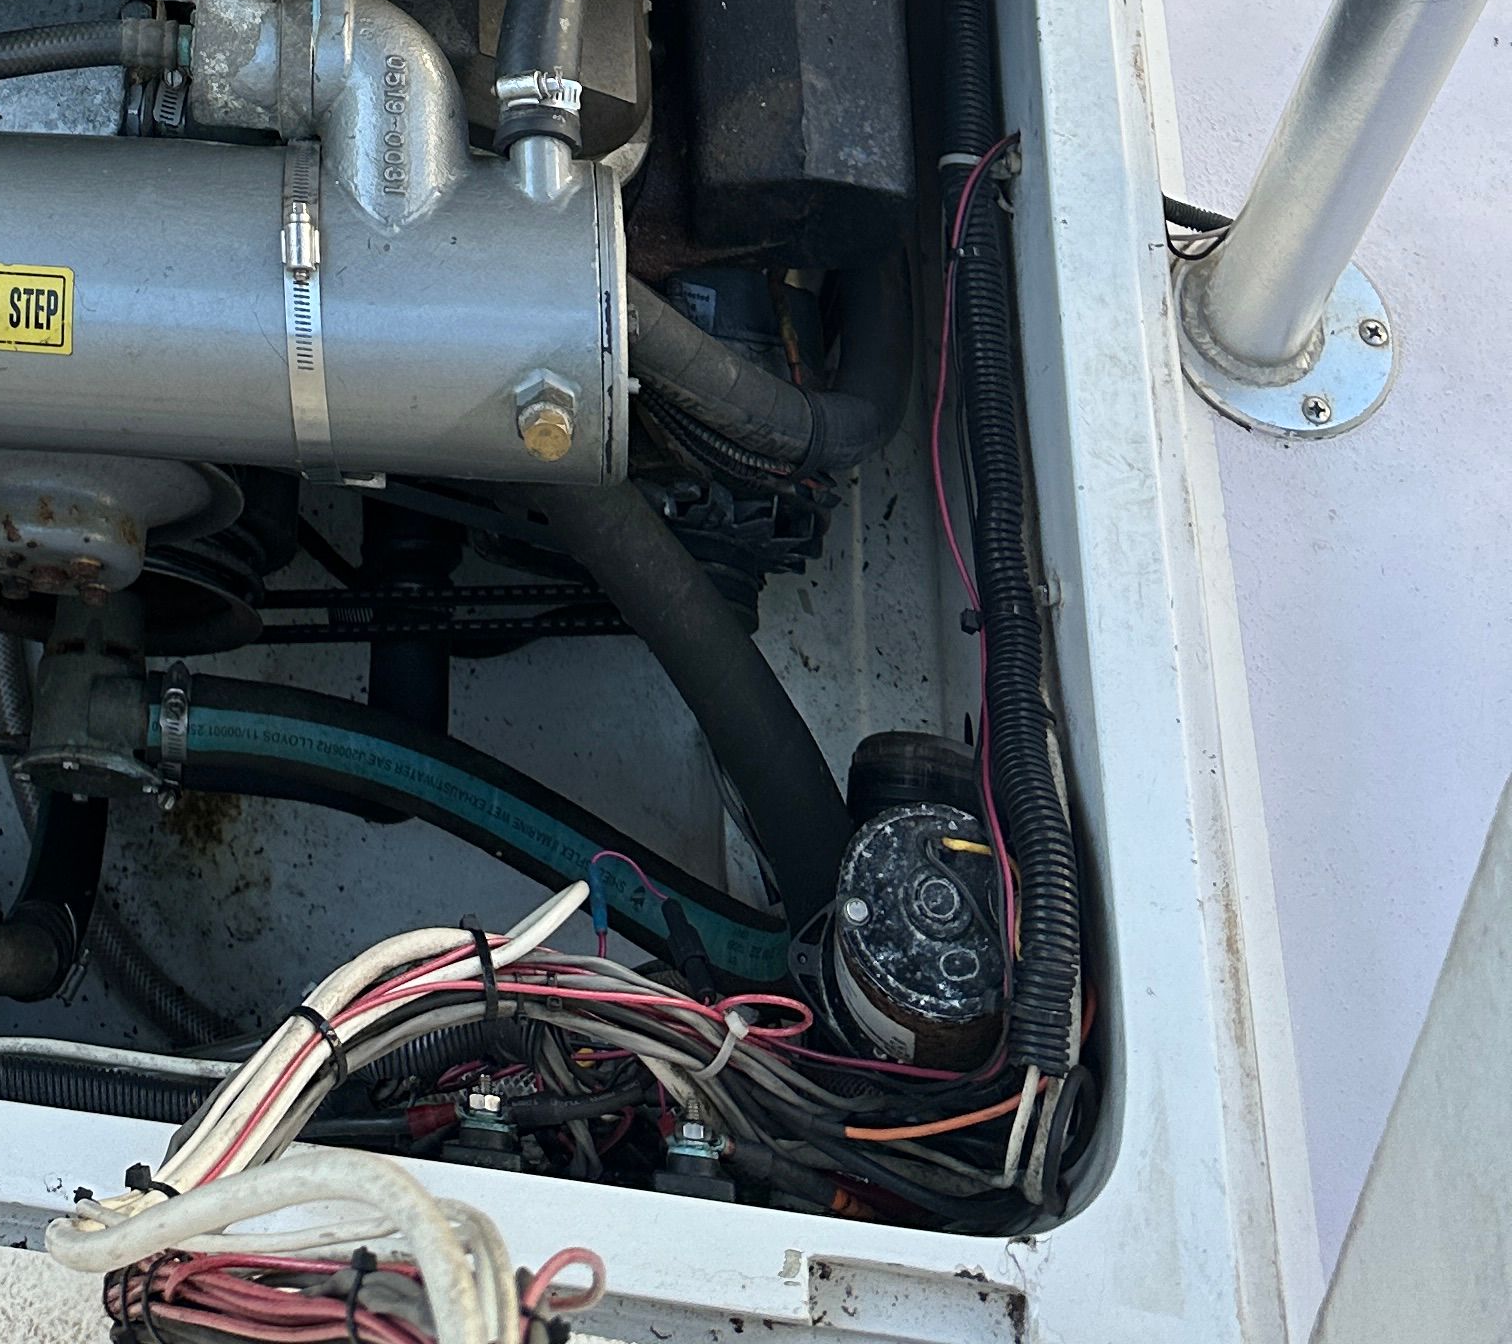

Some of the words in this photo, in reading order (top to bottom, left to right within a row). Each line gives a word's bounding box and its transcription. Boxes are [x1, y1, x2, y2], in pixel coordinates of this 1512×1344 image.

[384, 54, 409, 197] 0519-0031
[9, 287, 59, 330] STEP
[263, 729, 313, 748] LLOYDS
[316, 739, 367, 761] J2006R2
[368, 753, 392, 771] SAE
[487, 805, 510, 825] WET
[512, 817, 553, 848] MARINE
